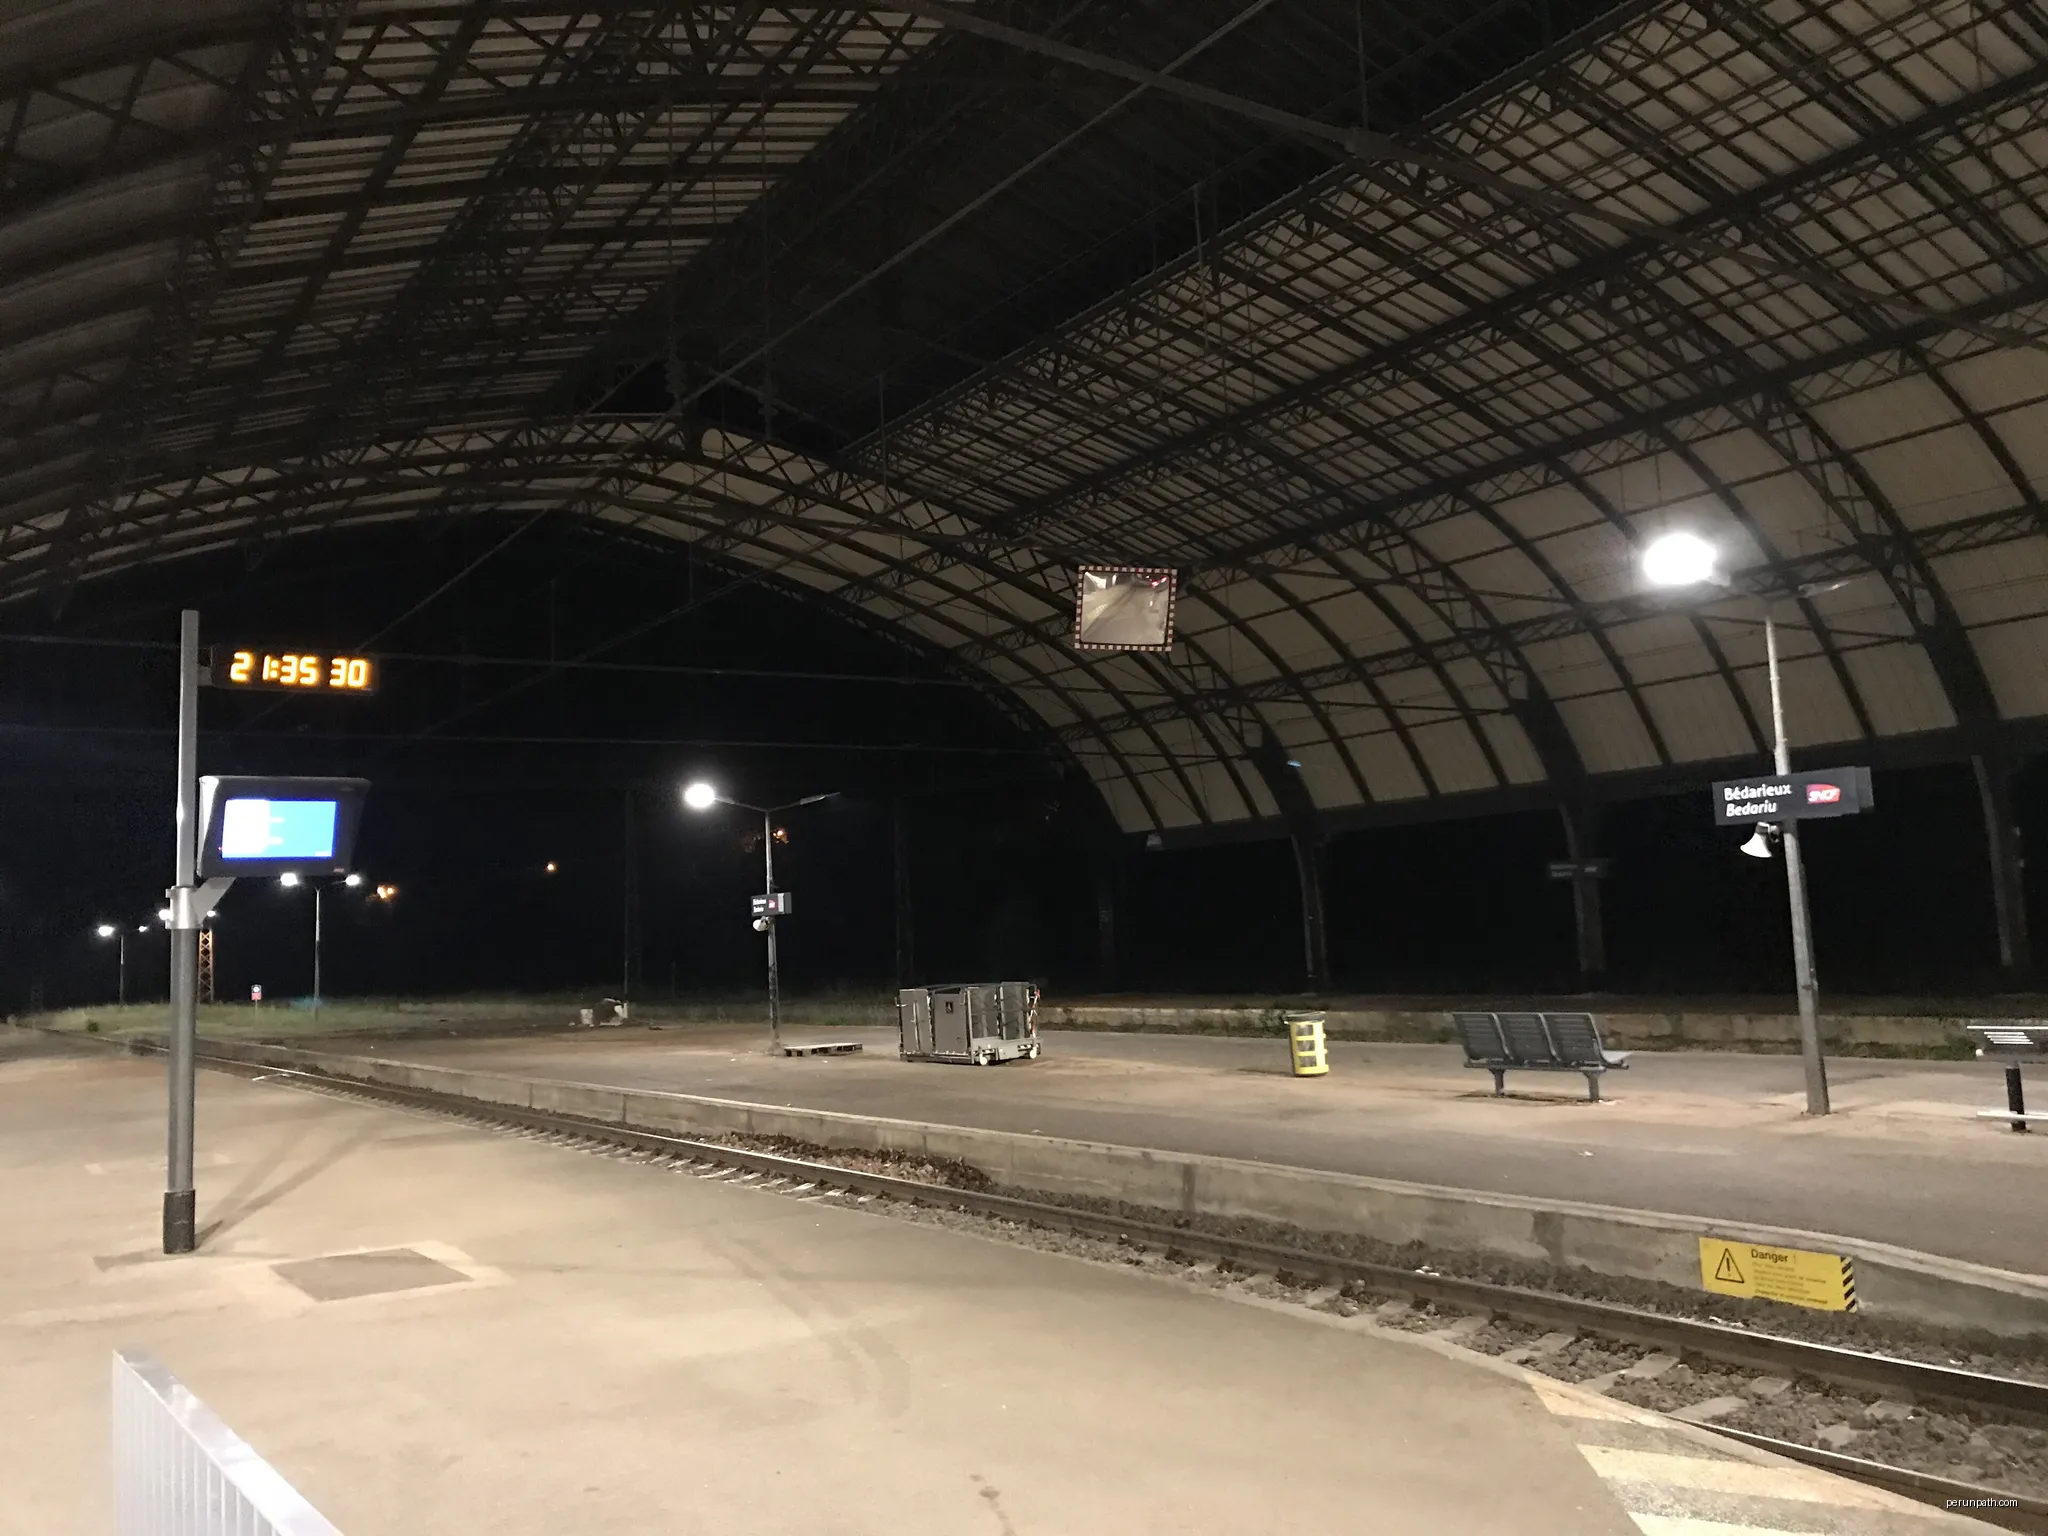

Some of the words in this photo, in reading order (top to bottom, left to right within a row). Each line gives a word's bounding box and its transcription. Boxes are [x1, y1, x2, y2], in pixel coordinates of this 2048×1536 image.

[230, 652, 318, 685] 21:35
[329, 658, 367, 687] 30
[1724, 784, 1791, 801] Bédarieux
[1808, 787, 1840, 803] SNCF
[1726, 800, 1777, 817] Bedariu
[1751, 1249, 1788, 1263] Danger
